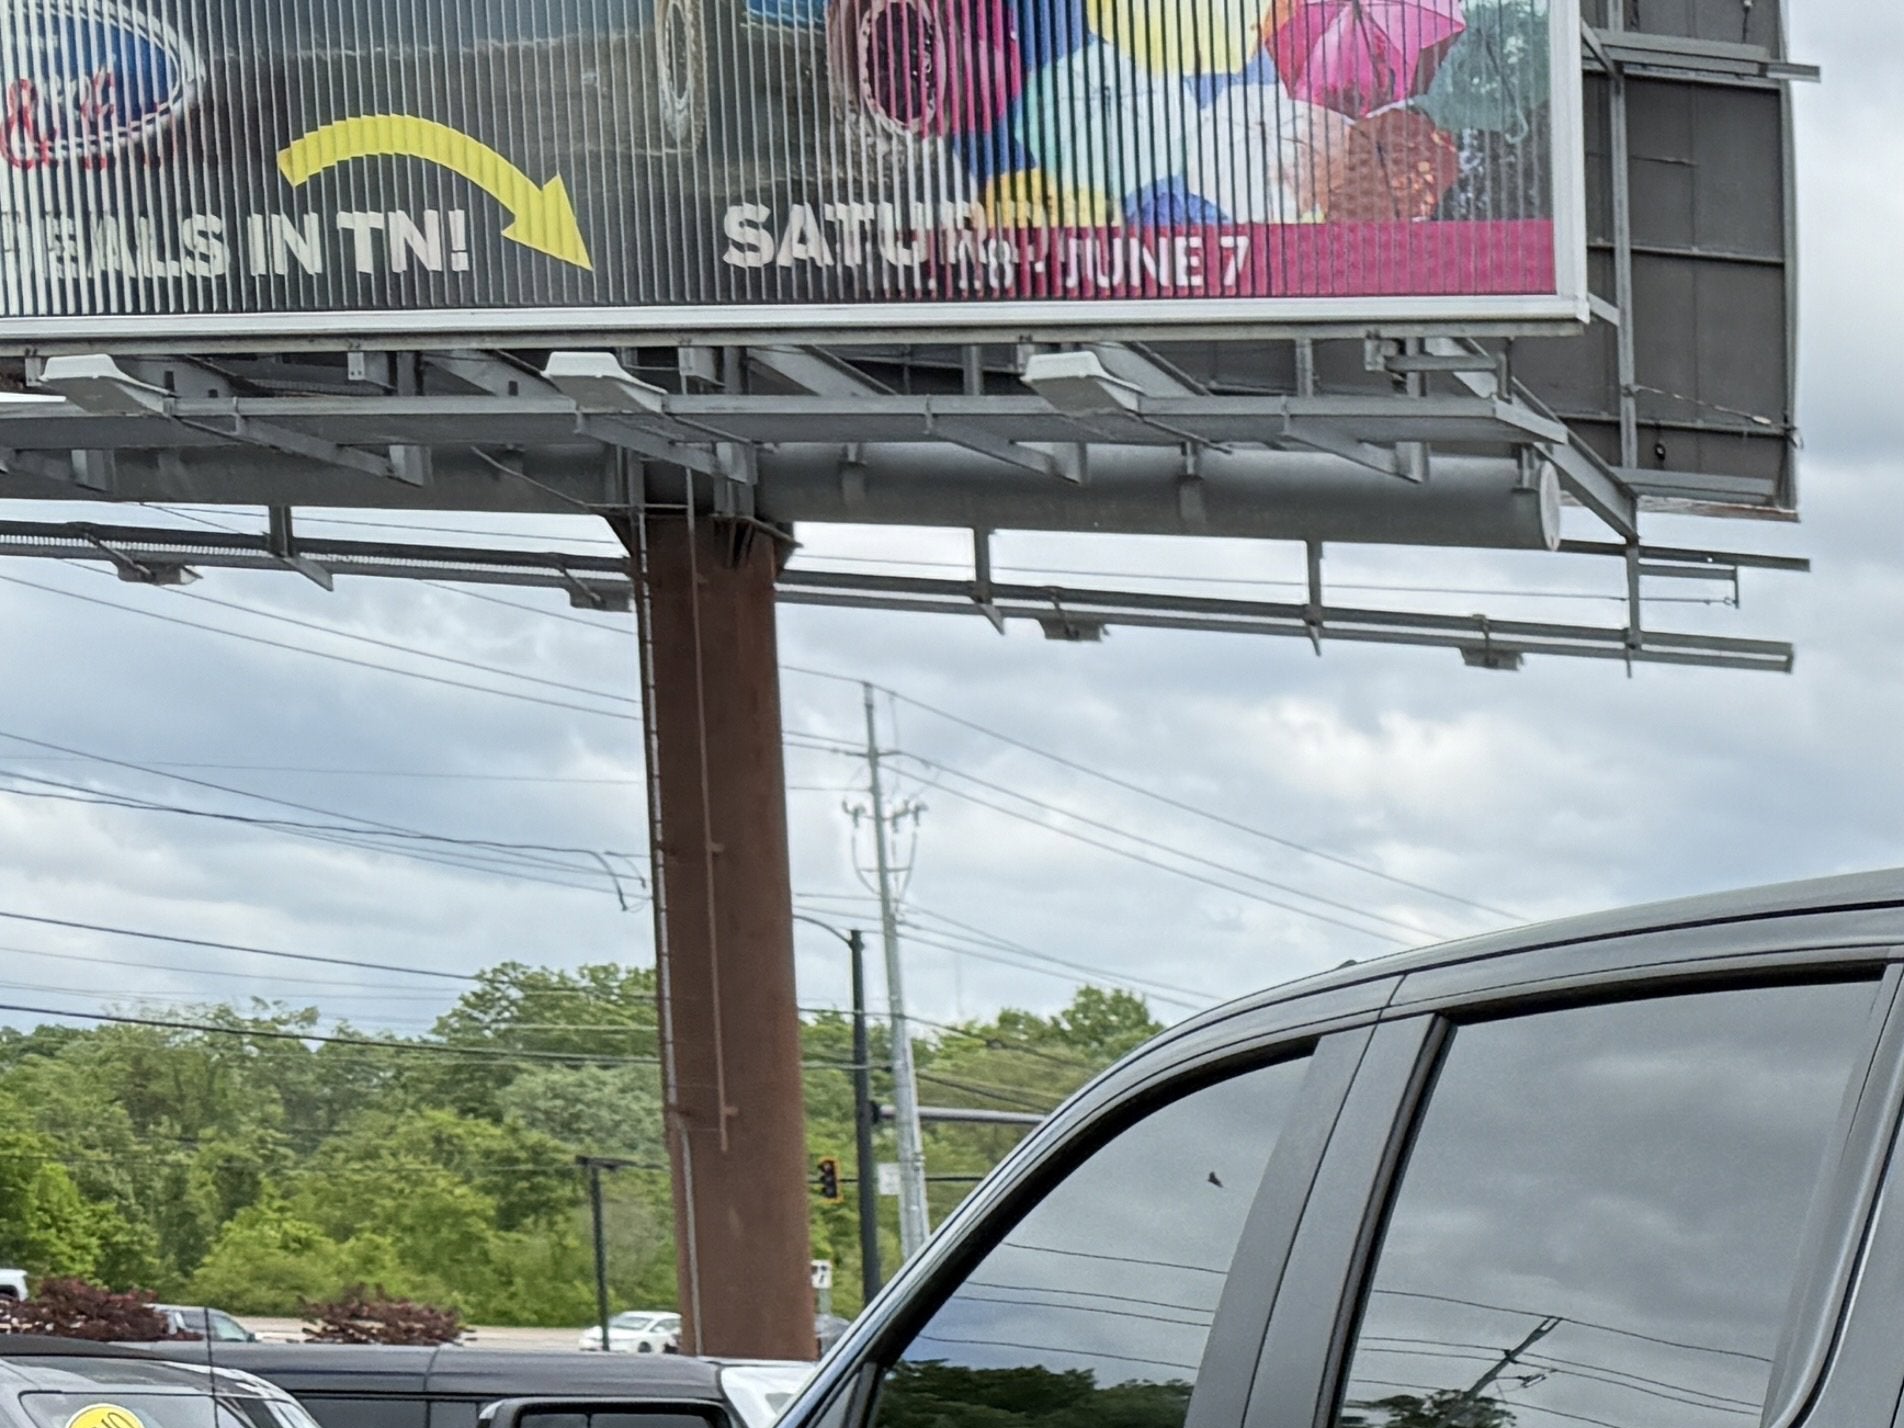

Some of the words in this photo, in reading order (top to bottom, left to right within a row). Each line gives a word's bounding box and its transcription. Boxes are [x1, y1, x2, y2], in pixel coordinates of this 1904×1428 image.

[248, 213, 322, 276] IN
[336, 209, 469, 274] TN!
[1220, 235, 1249, 287] 7
